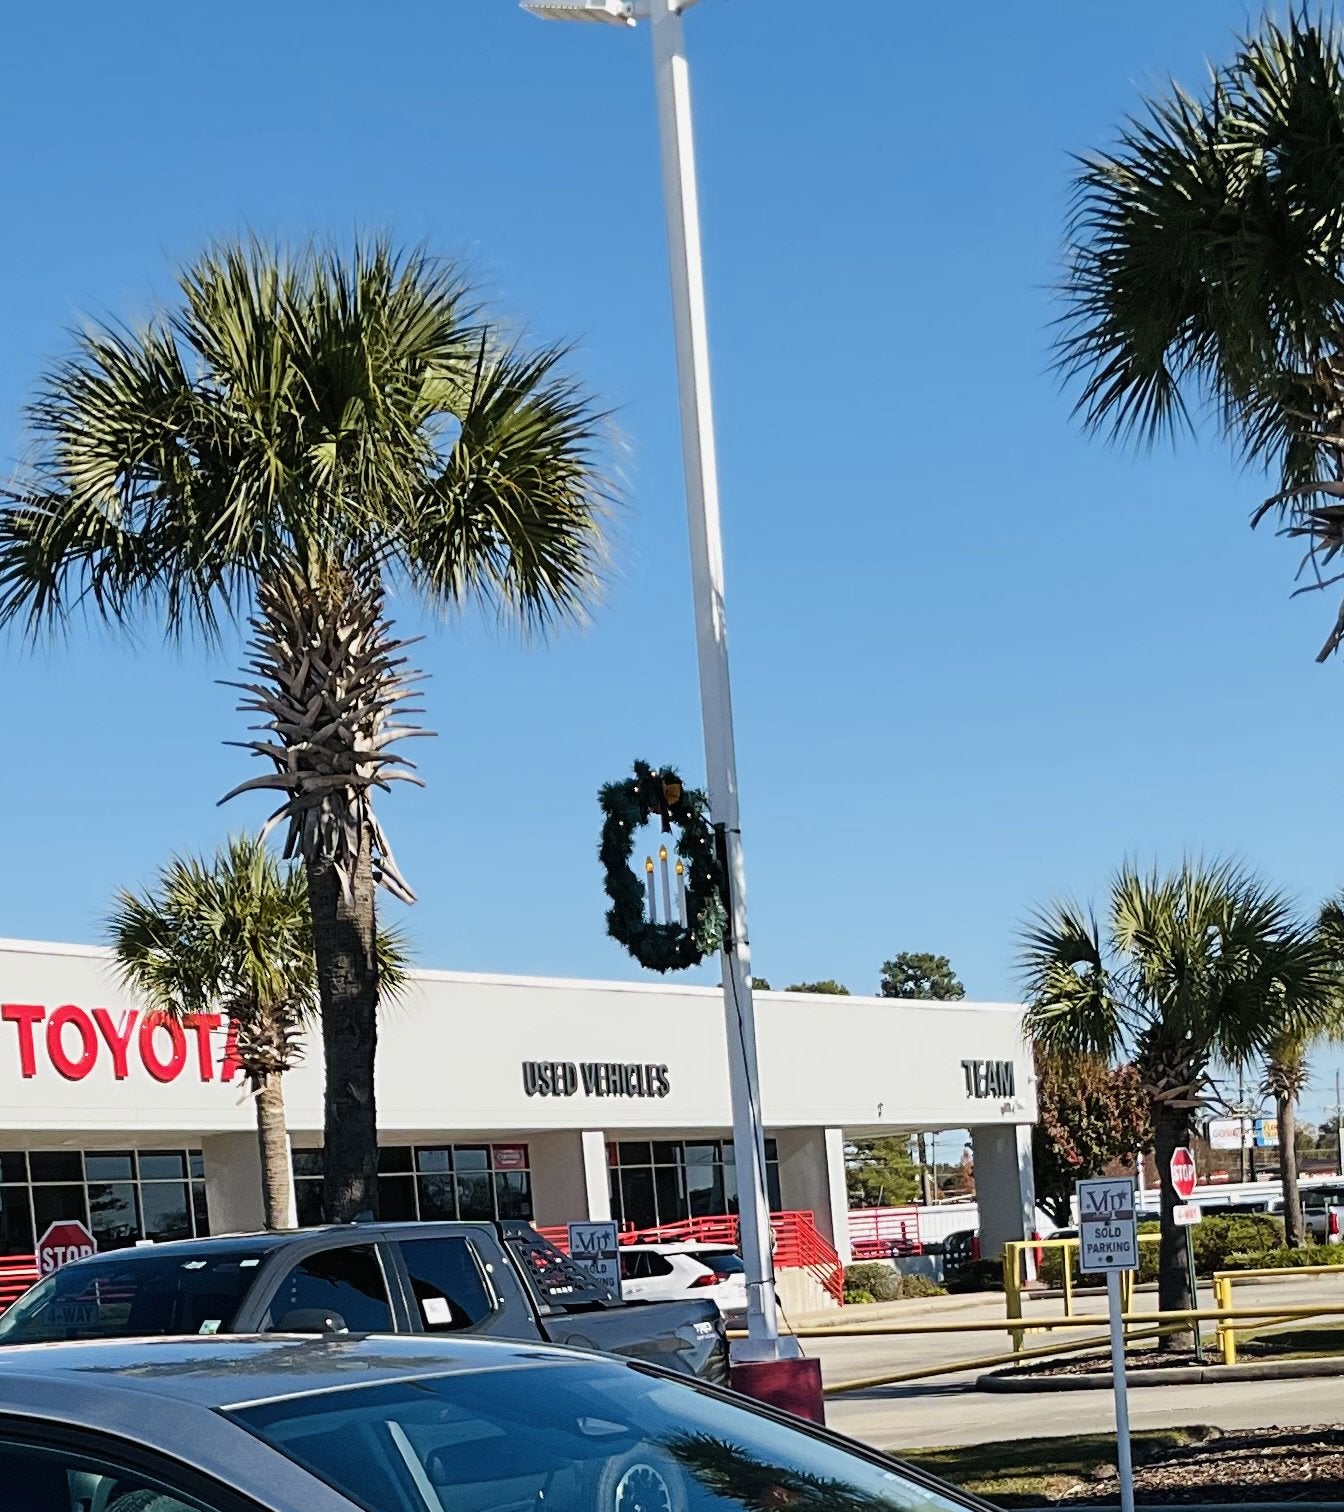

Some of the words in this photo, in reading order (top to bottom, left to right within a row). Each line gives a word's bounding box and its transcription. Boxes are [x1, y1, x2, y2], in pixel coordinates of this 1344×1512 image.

[521, 1061, 578, 1097] USED
[579, 1062, 670, 1098] VEHICLES
[960, 1060, 1015, 1098] TEAM
[1173, 1164, 1194, 1182] STOP
[1095, 1227, 1121, 1239] SOLD
[1087, 1241, 1130, 1254] PARKING
[48, 1306, 92, 1323] 4-WAY
